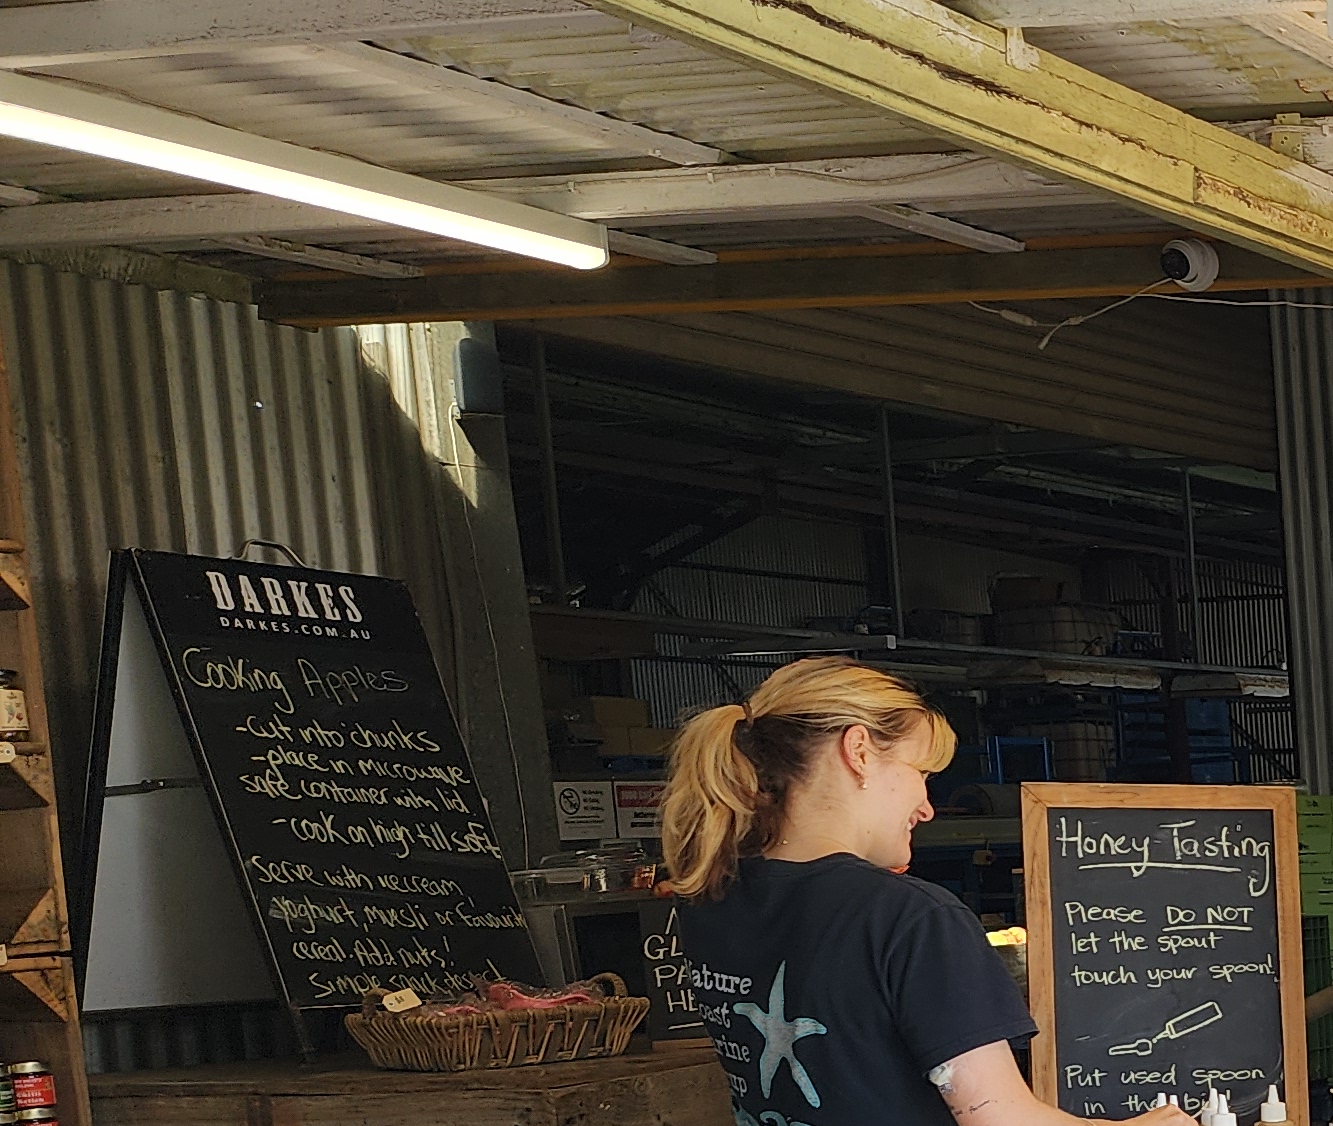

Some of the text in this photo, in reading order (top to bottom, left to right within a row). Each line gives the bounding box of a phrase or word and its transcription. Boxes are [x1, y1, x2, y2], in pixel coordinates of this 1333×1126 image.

[205, 571, 364, 623] DARKES
[219, 616, 373, 640] DARKES.COM.AU
[183, 648, 409, 713] Cooking Apples
[251, 855, 324, 886] Serve
[1056, 816, 1149, 878] Honey
[1158, 819, 1272, 898] Tasting
[1064, 901, 1148, 927] Please
[1206, 904, 1254, 926] NOT
[1070, 931, 1224, 959] let the spout
[1070, 963, 1138, 987] touch
[1147, 967, 1198, 989] your
[1064, 1063, 1266, 1093] Put used spoon
[1083, 1099, 1107, 1117] in
